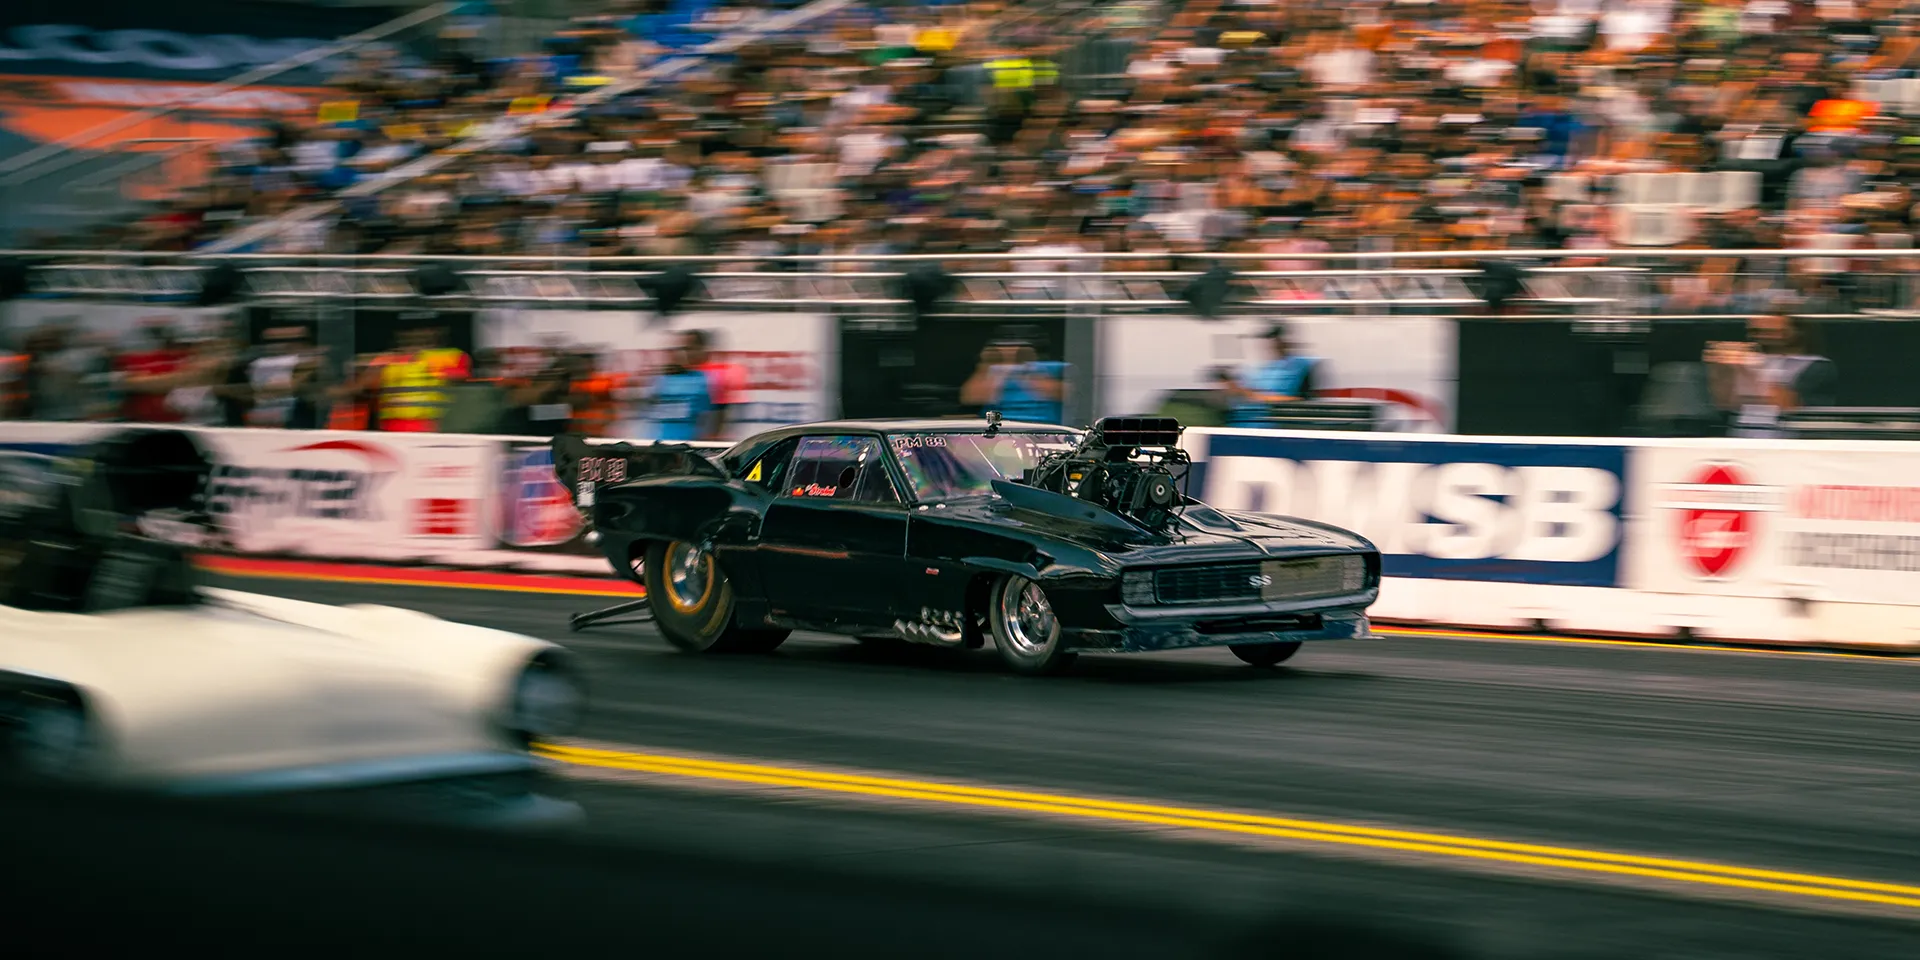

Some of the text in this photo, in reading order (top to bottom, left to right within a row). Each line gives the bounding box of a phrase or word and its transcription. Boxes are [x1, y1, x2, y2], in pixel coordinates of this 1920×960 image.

[896, 437, 947, 448] PM 89
[1204, 455, 1621, 562] DMSB
[1249, 575, 1272, 587] SS
